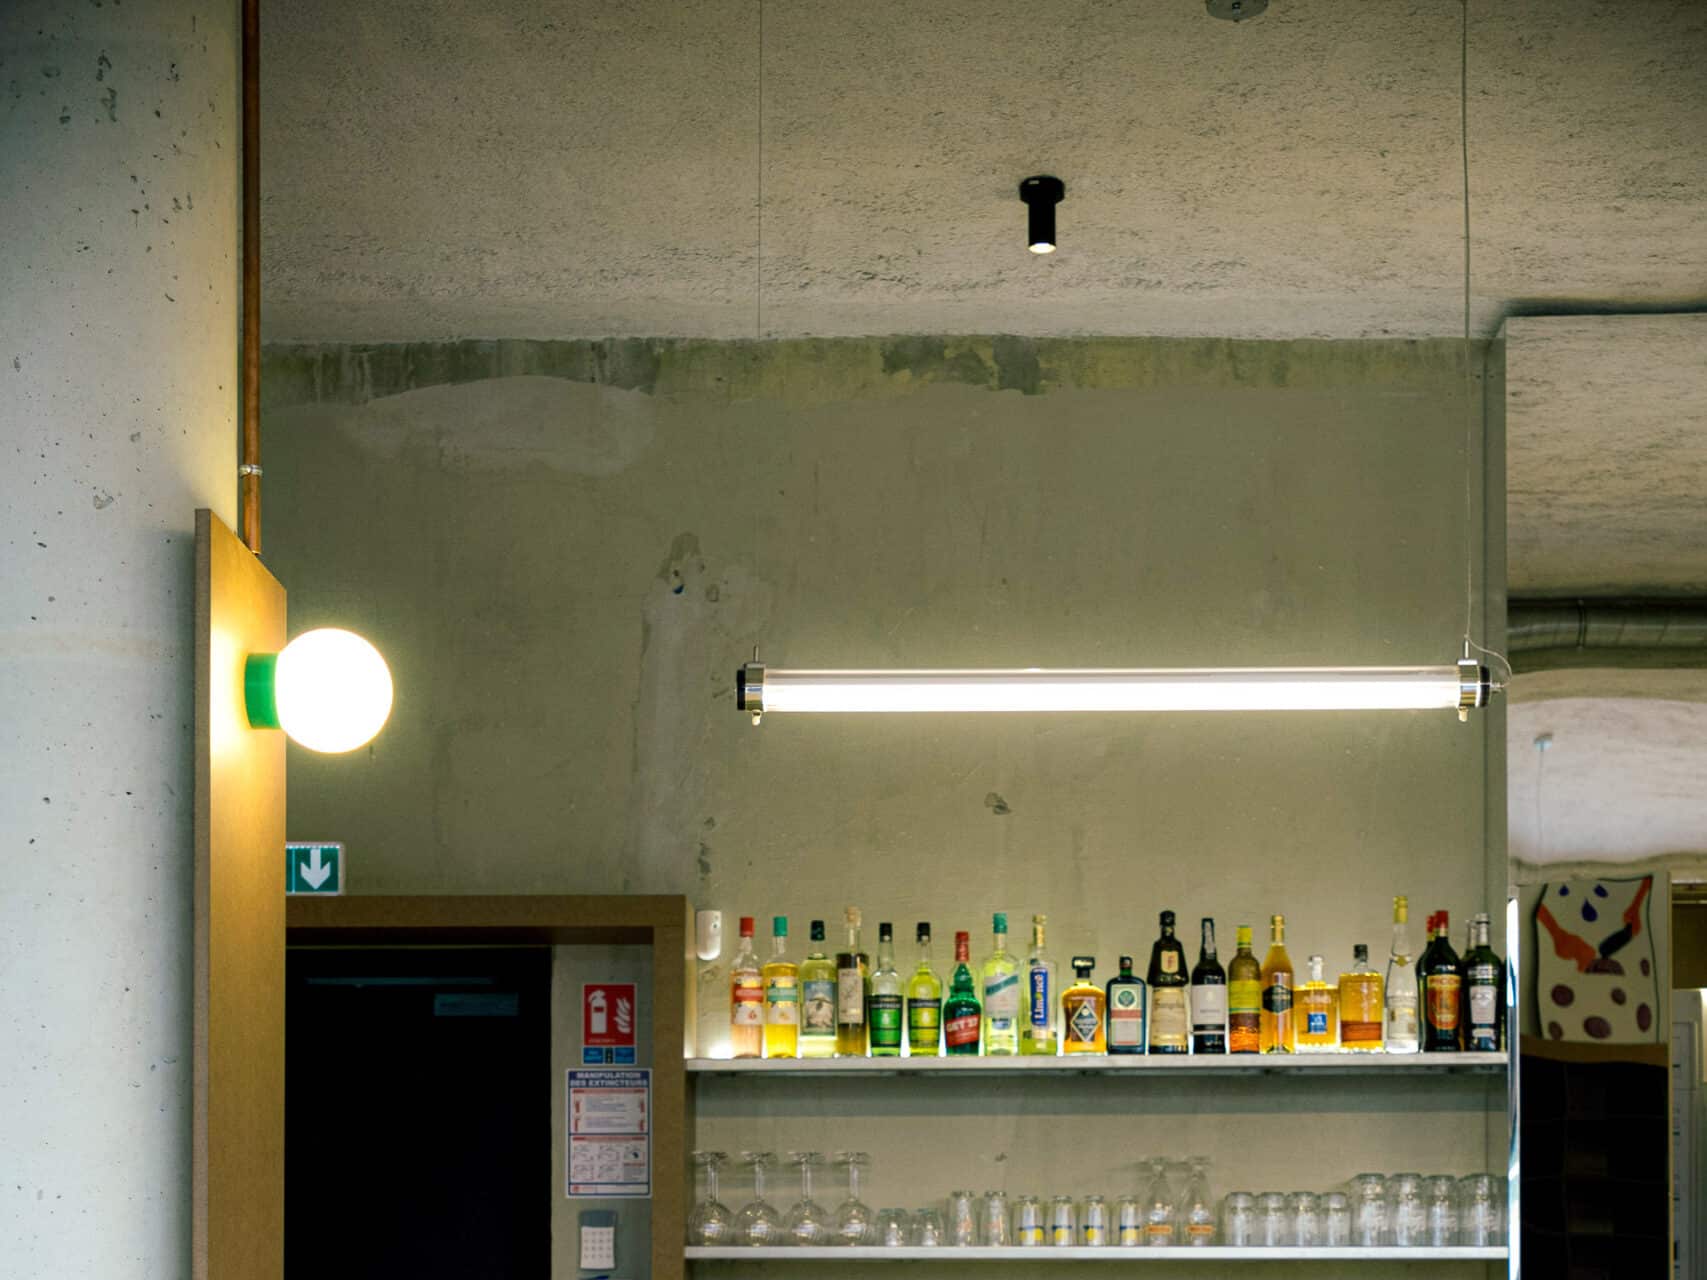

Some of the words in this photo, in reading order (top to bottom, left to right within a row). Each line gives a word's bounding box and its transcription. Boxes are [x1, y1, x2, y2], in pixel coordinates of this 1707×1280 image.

[576, 1071, 641, 1079] MANIPULATION
[570, 1079, 587, 1087] DES
[589, 1079, 648, 1087] EXTINCTEURS
